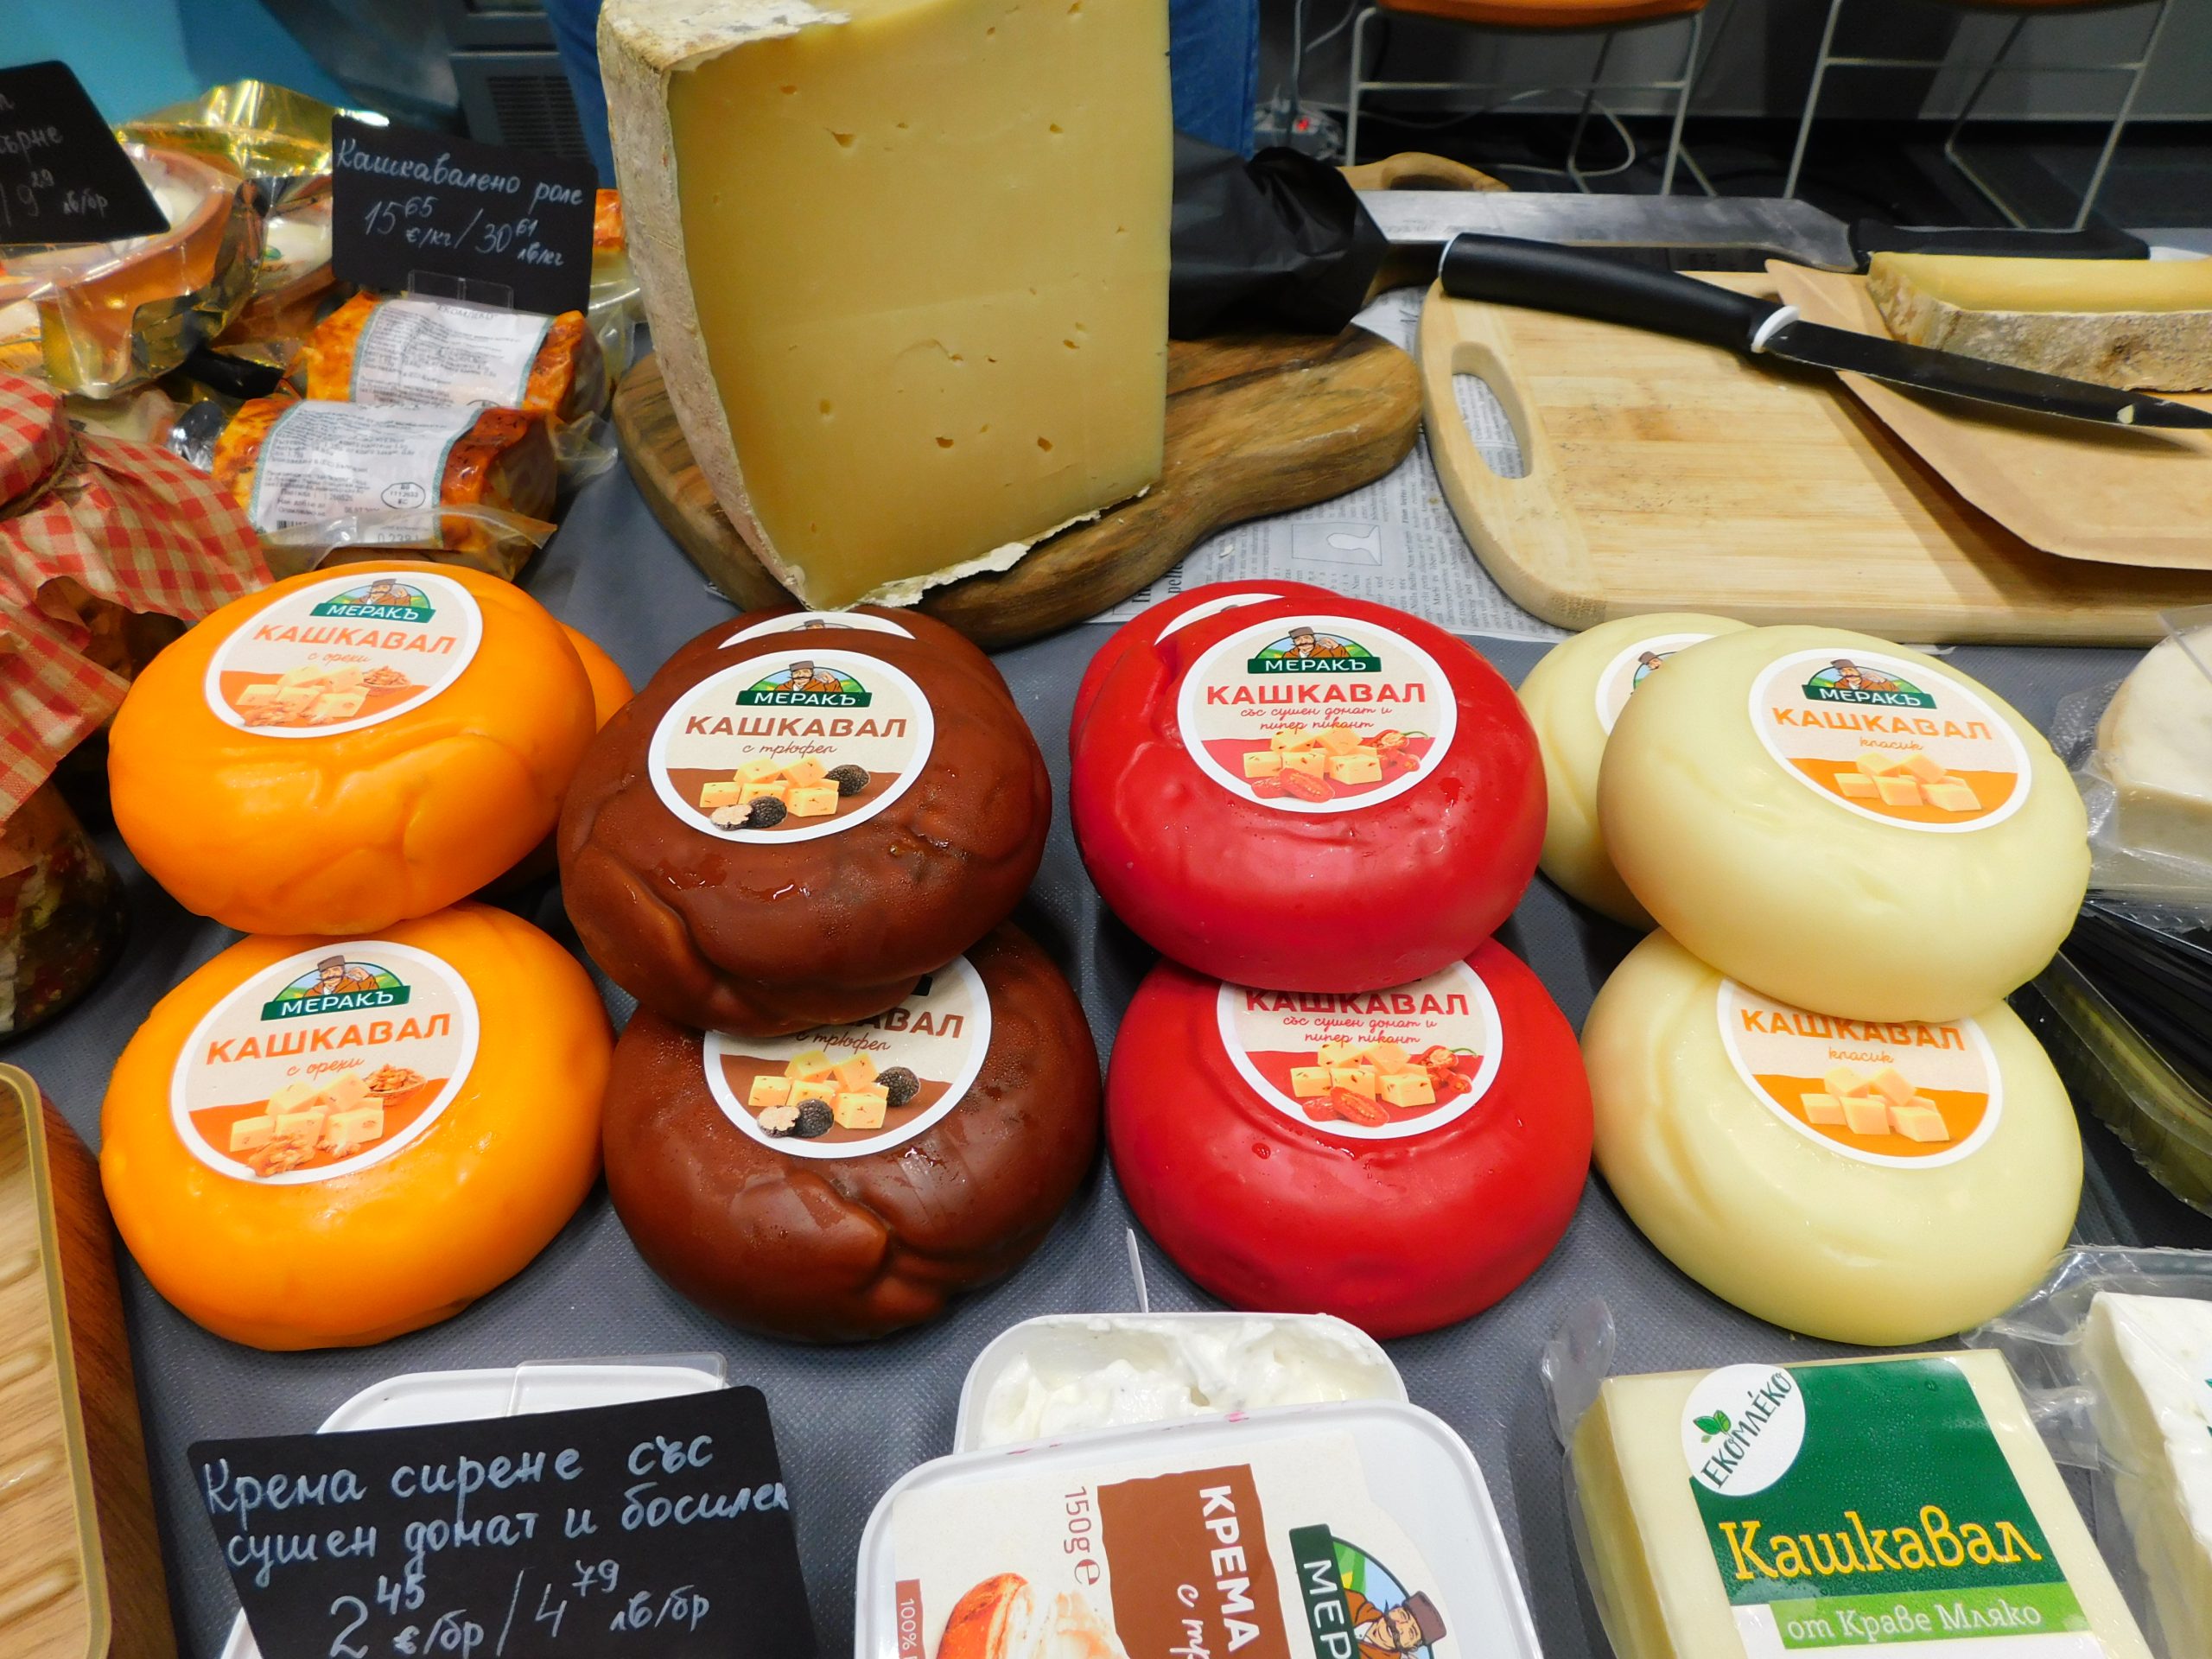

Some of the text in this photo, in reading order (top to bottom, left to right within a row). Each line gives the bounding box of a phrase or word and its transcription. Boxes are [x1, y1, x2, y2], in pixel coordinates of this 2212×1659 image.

[336, 138, 583, 215] Кашкавалено роле
[327, 604, 419, 620] МЕРАКЪ
[252, 623, 458, 655] КАШКАВАЛ
[308, 652, 374, 665] с орехи
[1265, 658, 1367, 671] МЕРАКЪ
[753, 691, 856, 707] МЕРАКЪ
[1206, 683, 1427, 705] КАШКАВАЛ
[1819, 688, 1922, 707] МЕРАКЪ
[1240, 706, 1393, 722] със сушен домат и
[1259, 716, 1374, 734] пипер пикант
[1771, 707, 1993, 741] КАШКАВАЛ
[684, 715, 907, 738] КАШКАВАЛ
[741, 740, 838, 760] с трюфел
[1859, 736, 1924, 751] класик
[281, 990, 394, 1016] МЕРАКЪ
[1245, 990, 1469, 1015] КАШКАВАЛ
[1283, 1015, 1438, 1035] със сушен домат и
[1740, 1008, 1966, 1052] КАШКАВАЛ
[206, 1013, 452, 1065] КАШКАВАЛ
[812, 1030, 893, 1054] трюфел
[1304, 1028, 1421, 1047] пипер пикант
[1828, 1046, 1895, 1064] класик
[287, 1056, 365, 1080] с орехи
[204, 1434, 715, 1530] Крема сирене със
[226, 1522, 378, 1587] сушен
[404, 1511, 537, 1578] домат
[563, 1507, 598, 1539] и
[1718, 1504, 2043, 1580] Кашкавал
[1198, 1484, 1261, 1653] КРЕМА
[1177, 1583, 1199, 1608] с
[900, 1597, 918, 1651] 100%
[1787, 1599, 2043, 1643] от Краве Мляко
